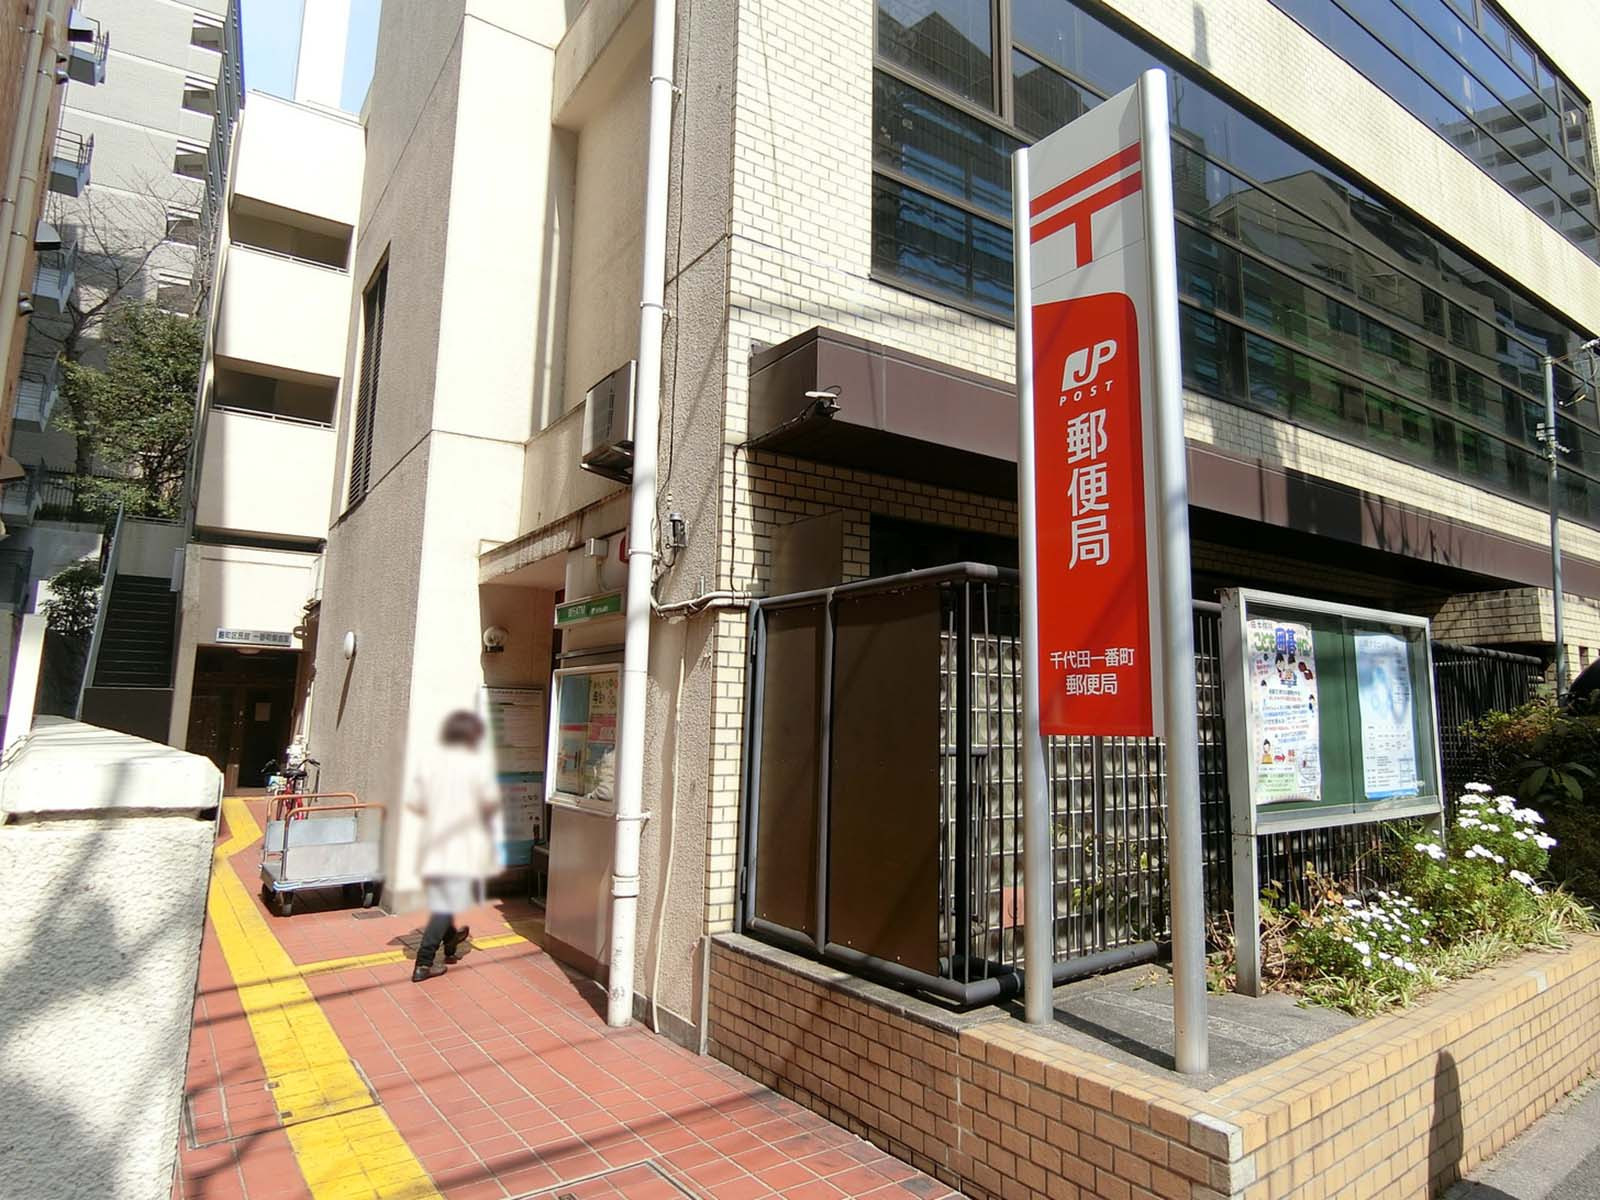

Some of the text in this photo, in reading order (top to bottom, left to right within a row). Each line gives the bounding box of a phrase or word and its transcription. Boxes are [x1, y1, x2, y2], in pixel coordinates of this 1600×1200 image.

[1058, 379, 1114, 407] POST
[1066, 408, 1111, 570] 郵便局
[1049, 647, 1136, 670] 千代田一番町
[1065, 673, 1118, 696] 郵便局
